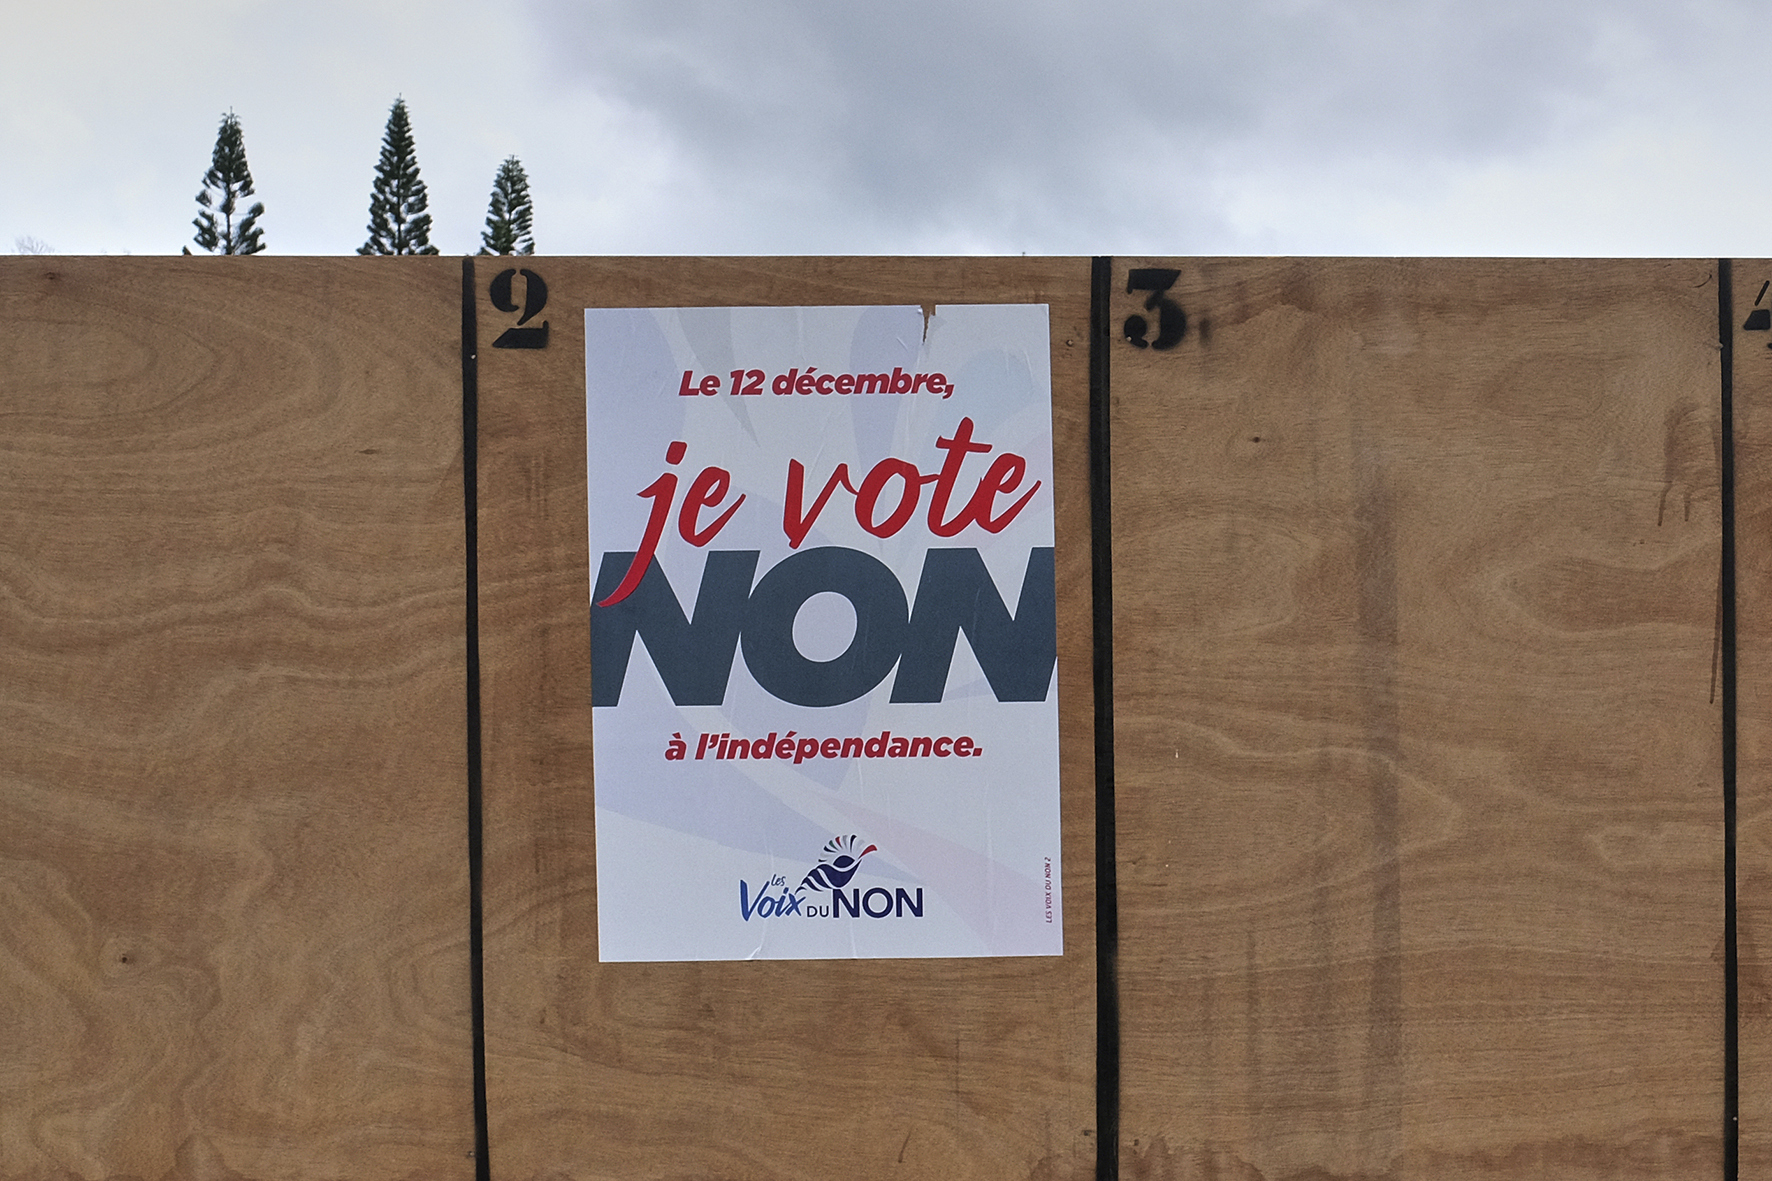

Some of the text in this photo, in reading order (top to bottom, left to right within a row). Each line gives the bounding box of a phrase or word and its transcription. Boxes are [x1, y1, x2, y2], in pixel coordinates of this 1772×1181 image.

[489, 268, 549, 349] 2
[1123, 268, 1188, 350] 3
[678, 367, 954, 400] Le 12 décembre,
[596, 416, 1042, 607] je vote
[590, 546, 1057, 707] NON
[664, 732, 686, 761] à
[1044, 863, 1052, 878] NON
[1045, 879, 1052, 891] DU
[740, 879, 924, 922] Voix DU NON
[1045, 910, 1053, 924] LES
